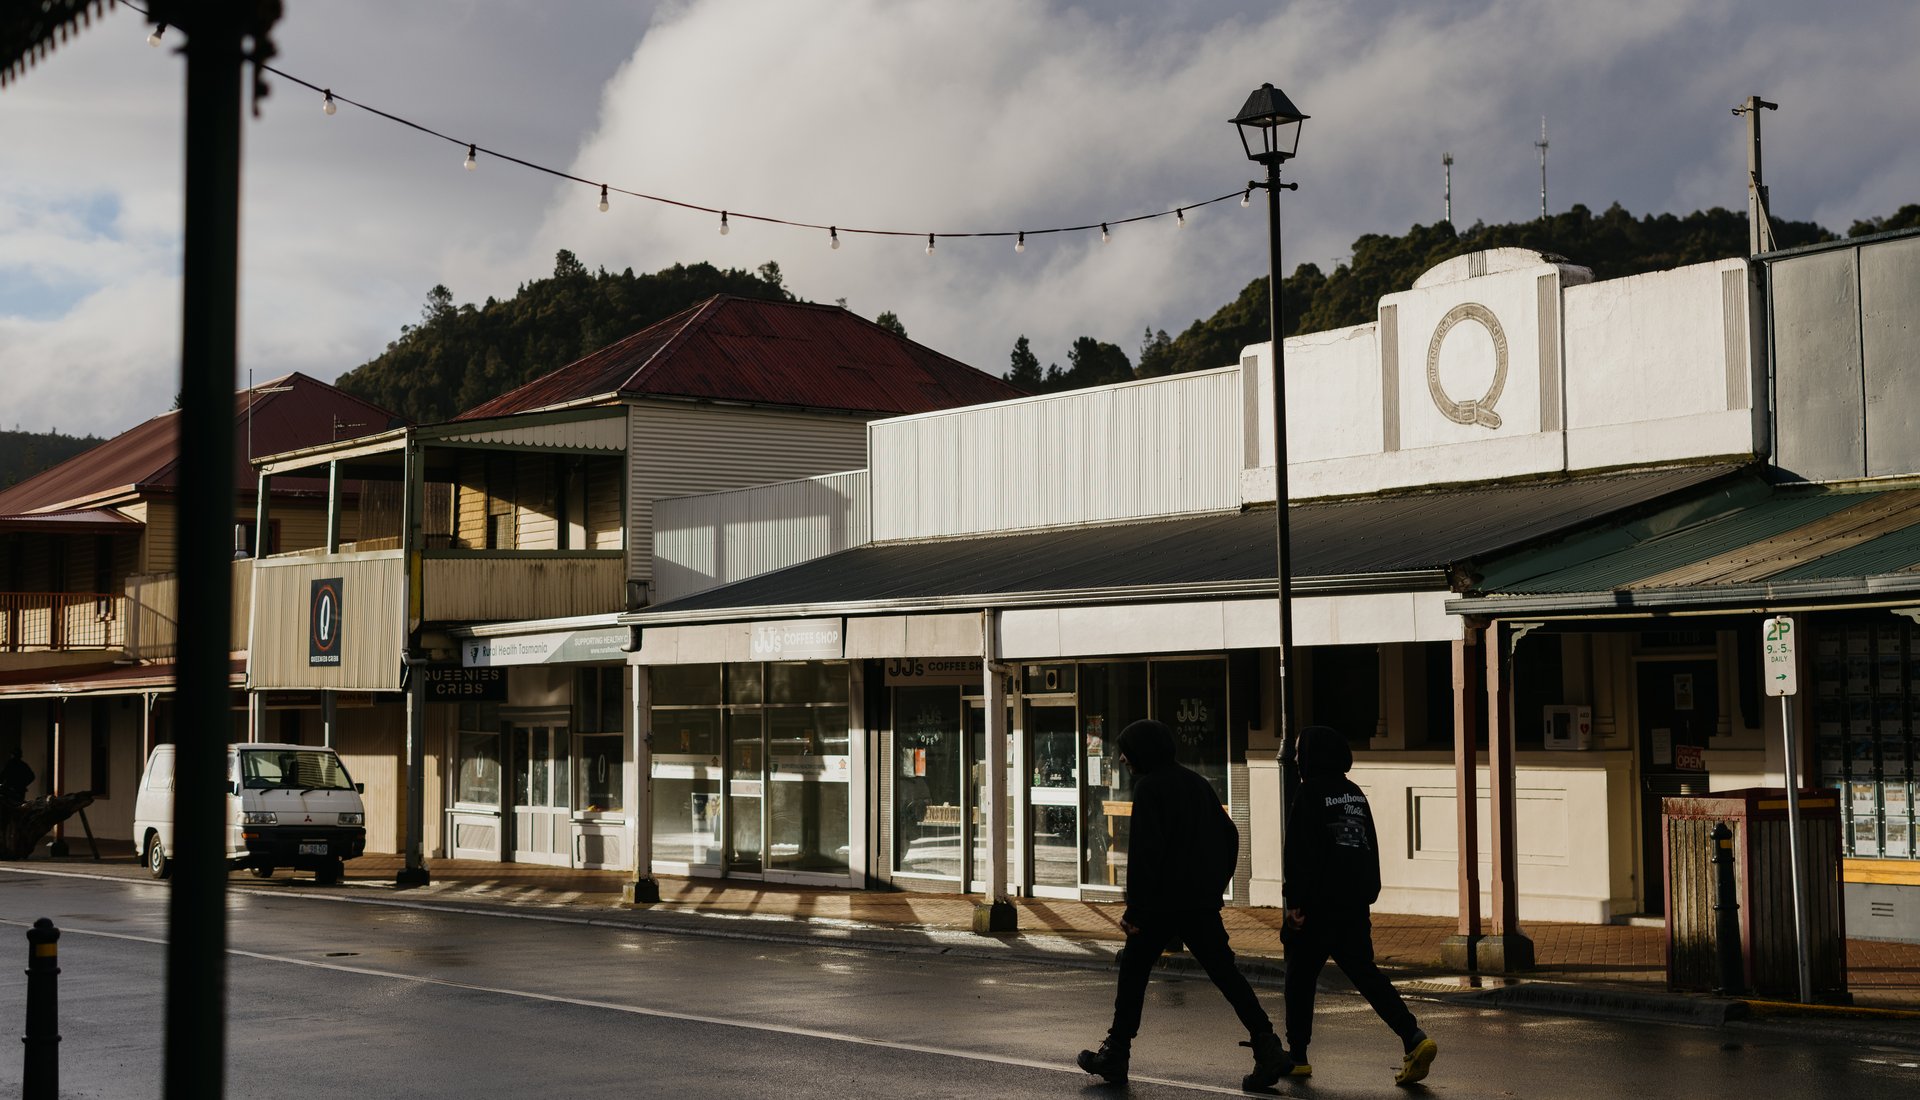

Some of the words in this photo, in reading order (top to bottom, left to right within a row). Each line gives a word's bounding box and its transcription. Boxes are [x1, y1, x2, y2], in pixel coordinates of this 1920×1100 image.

[320, 595, 330, 640] Q
[754, 627, 781, 653] JJ's
[784, 632, 814, 645] COFFEE
[815, 630, 838, 644] SHOP
[1766, 622, 1791, 641] 2P
[482, 646, 497, 657] Rural
[499, 645, 517, 656] Health
[518, 642, 547, 655] Tasmania
[1771, 655, 1788, 663] DAILY
[888, 657, 924, 677] JJ's
[928, 661, 966, 671] COFFEE
[968, 661, 983, 670] SH
[436, 683, 484, 695] CRIBS
[1176, 698, 1207, 722] JJ's
[1677, 755, 1702, 769] OPEN
